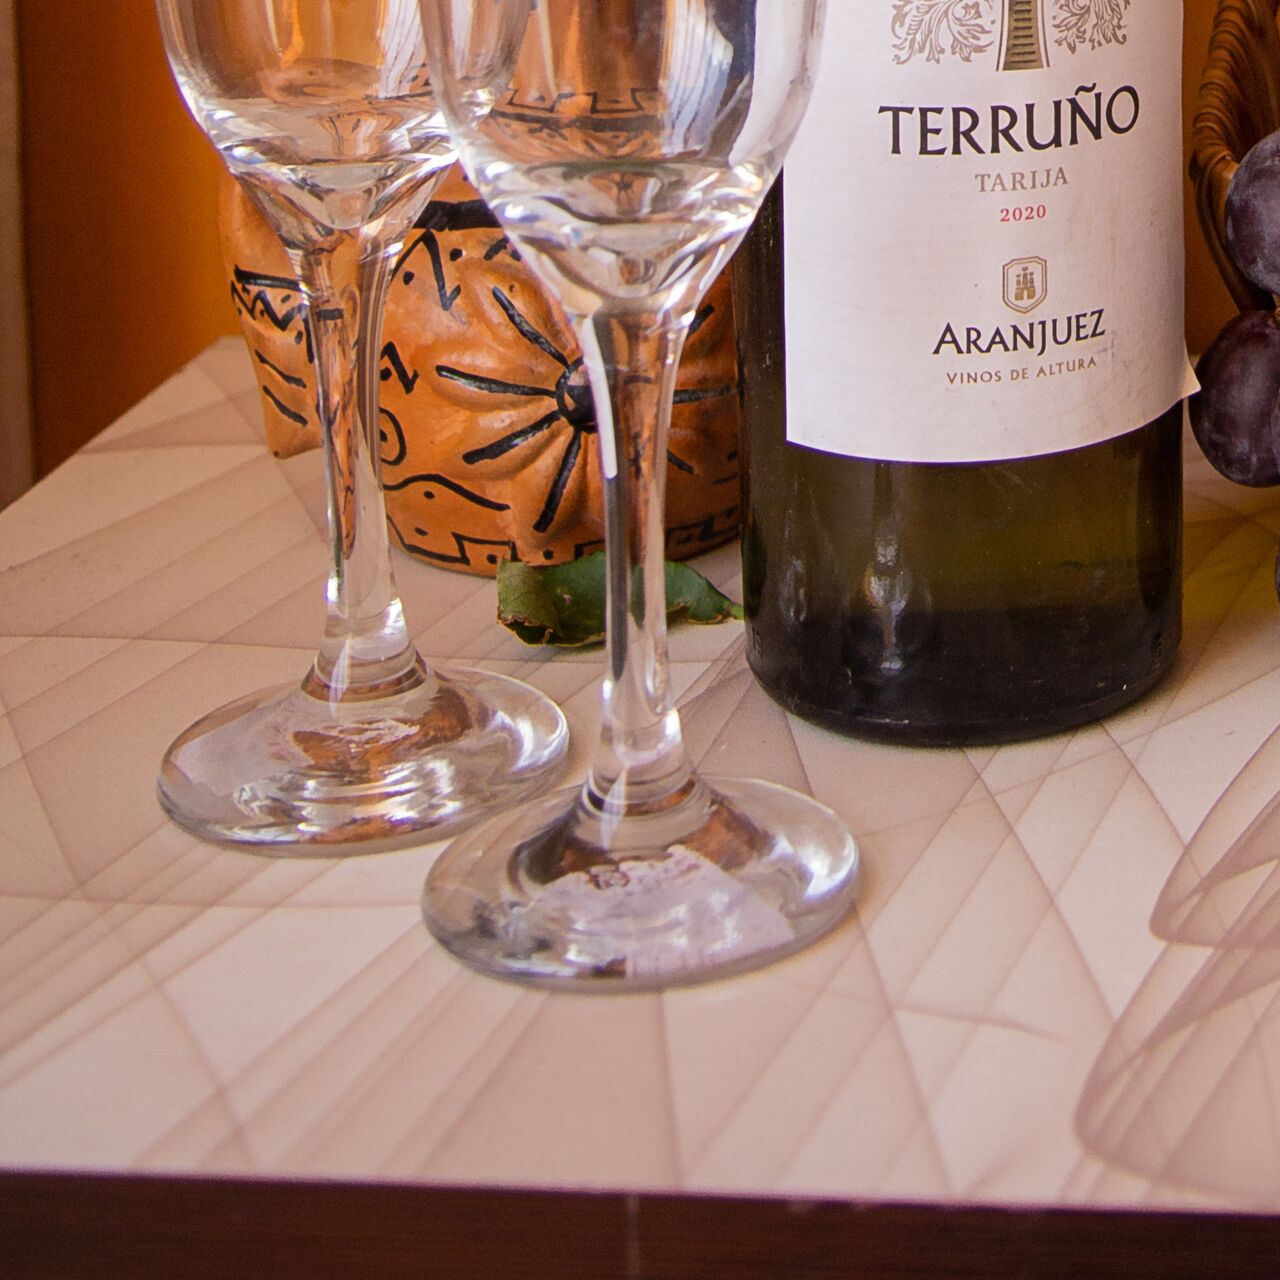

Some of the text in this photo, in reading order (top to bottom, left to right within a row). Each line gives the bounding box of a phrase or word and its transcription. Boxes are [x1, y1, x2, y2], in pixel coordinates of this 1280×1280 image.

[877, 82, 1140, 156] TERRUÑO
[974, 166, 1069, 192] TARIJA
[999, 204, 1047, 223] 2020
[932, 308, 1106, 357] ARANJUEZ
[946, 356, 1097, 385] VINOS DE ALTURA
